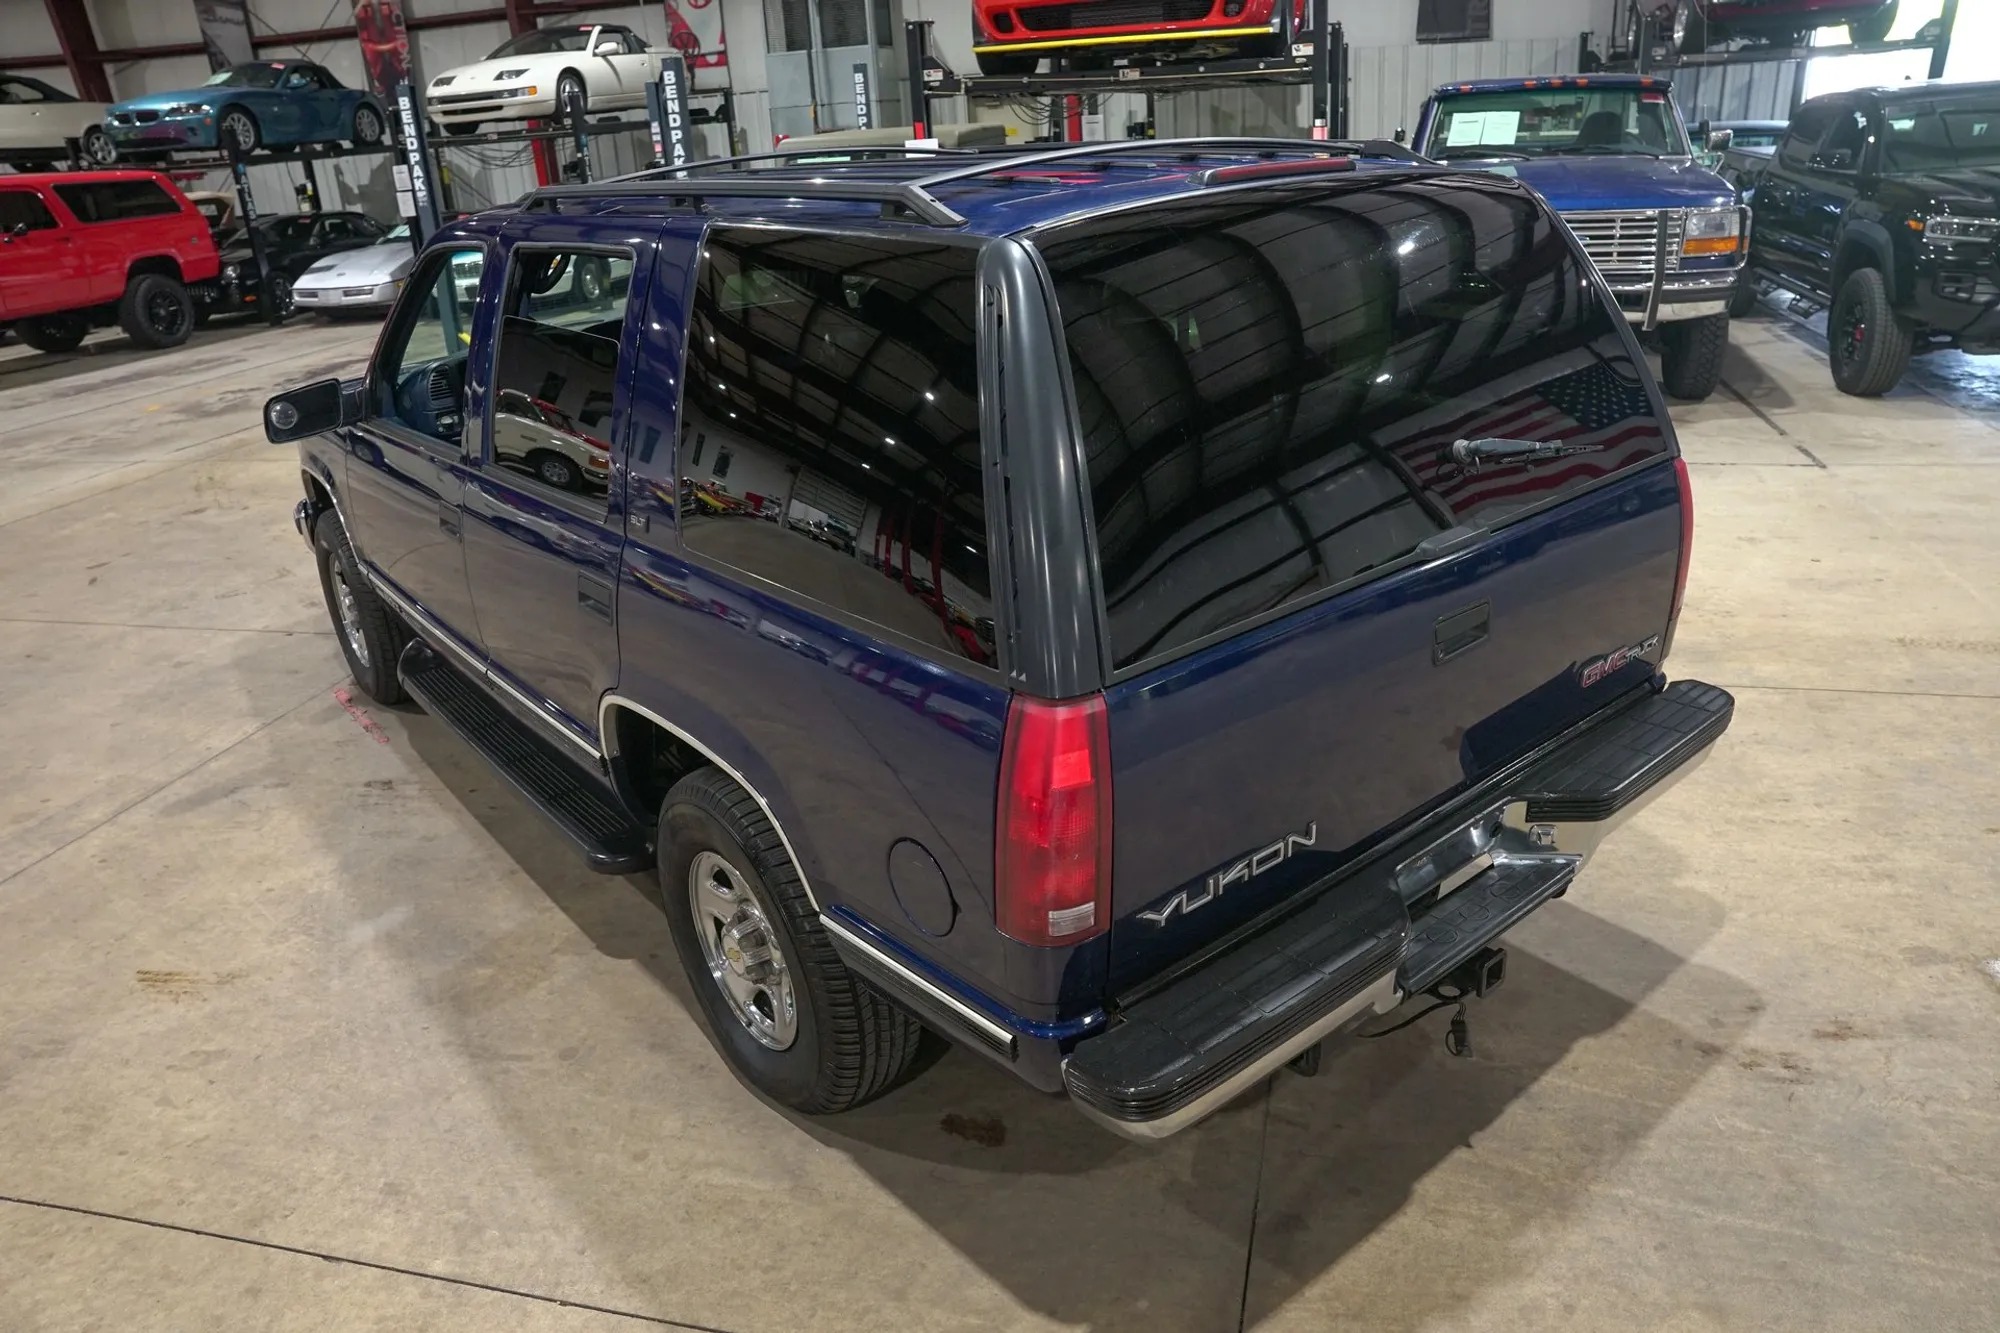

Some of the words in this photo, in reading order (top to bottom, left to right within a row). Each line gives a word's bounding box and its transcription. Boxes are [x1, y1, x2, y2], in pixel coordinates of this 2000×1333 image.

[398, 97, 425, 191] BENDPAK
[240, 174, 257, 219] ATLAS
[630, 514, 646, 526] SLT
[1582, 646, 1629, 688] GMC
[1136, 820, 1316, 927] YUKON
